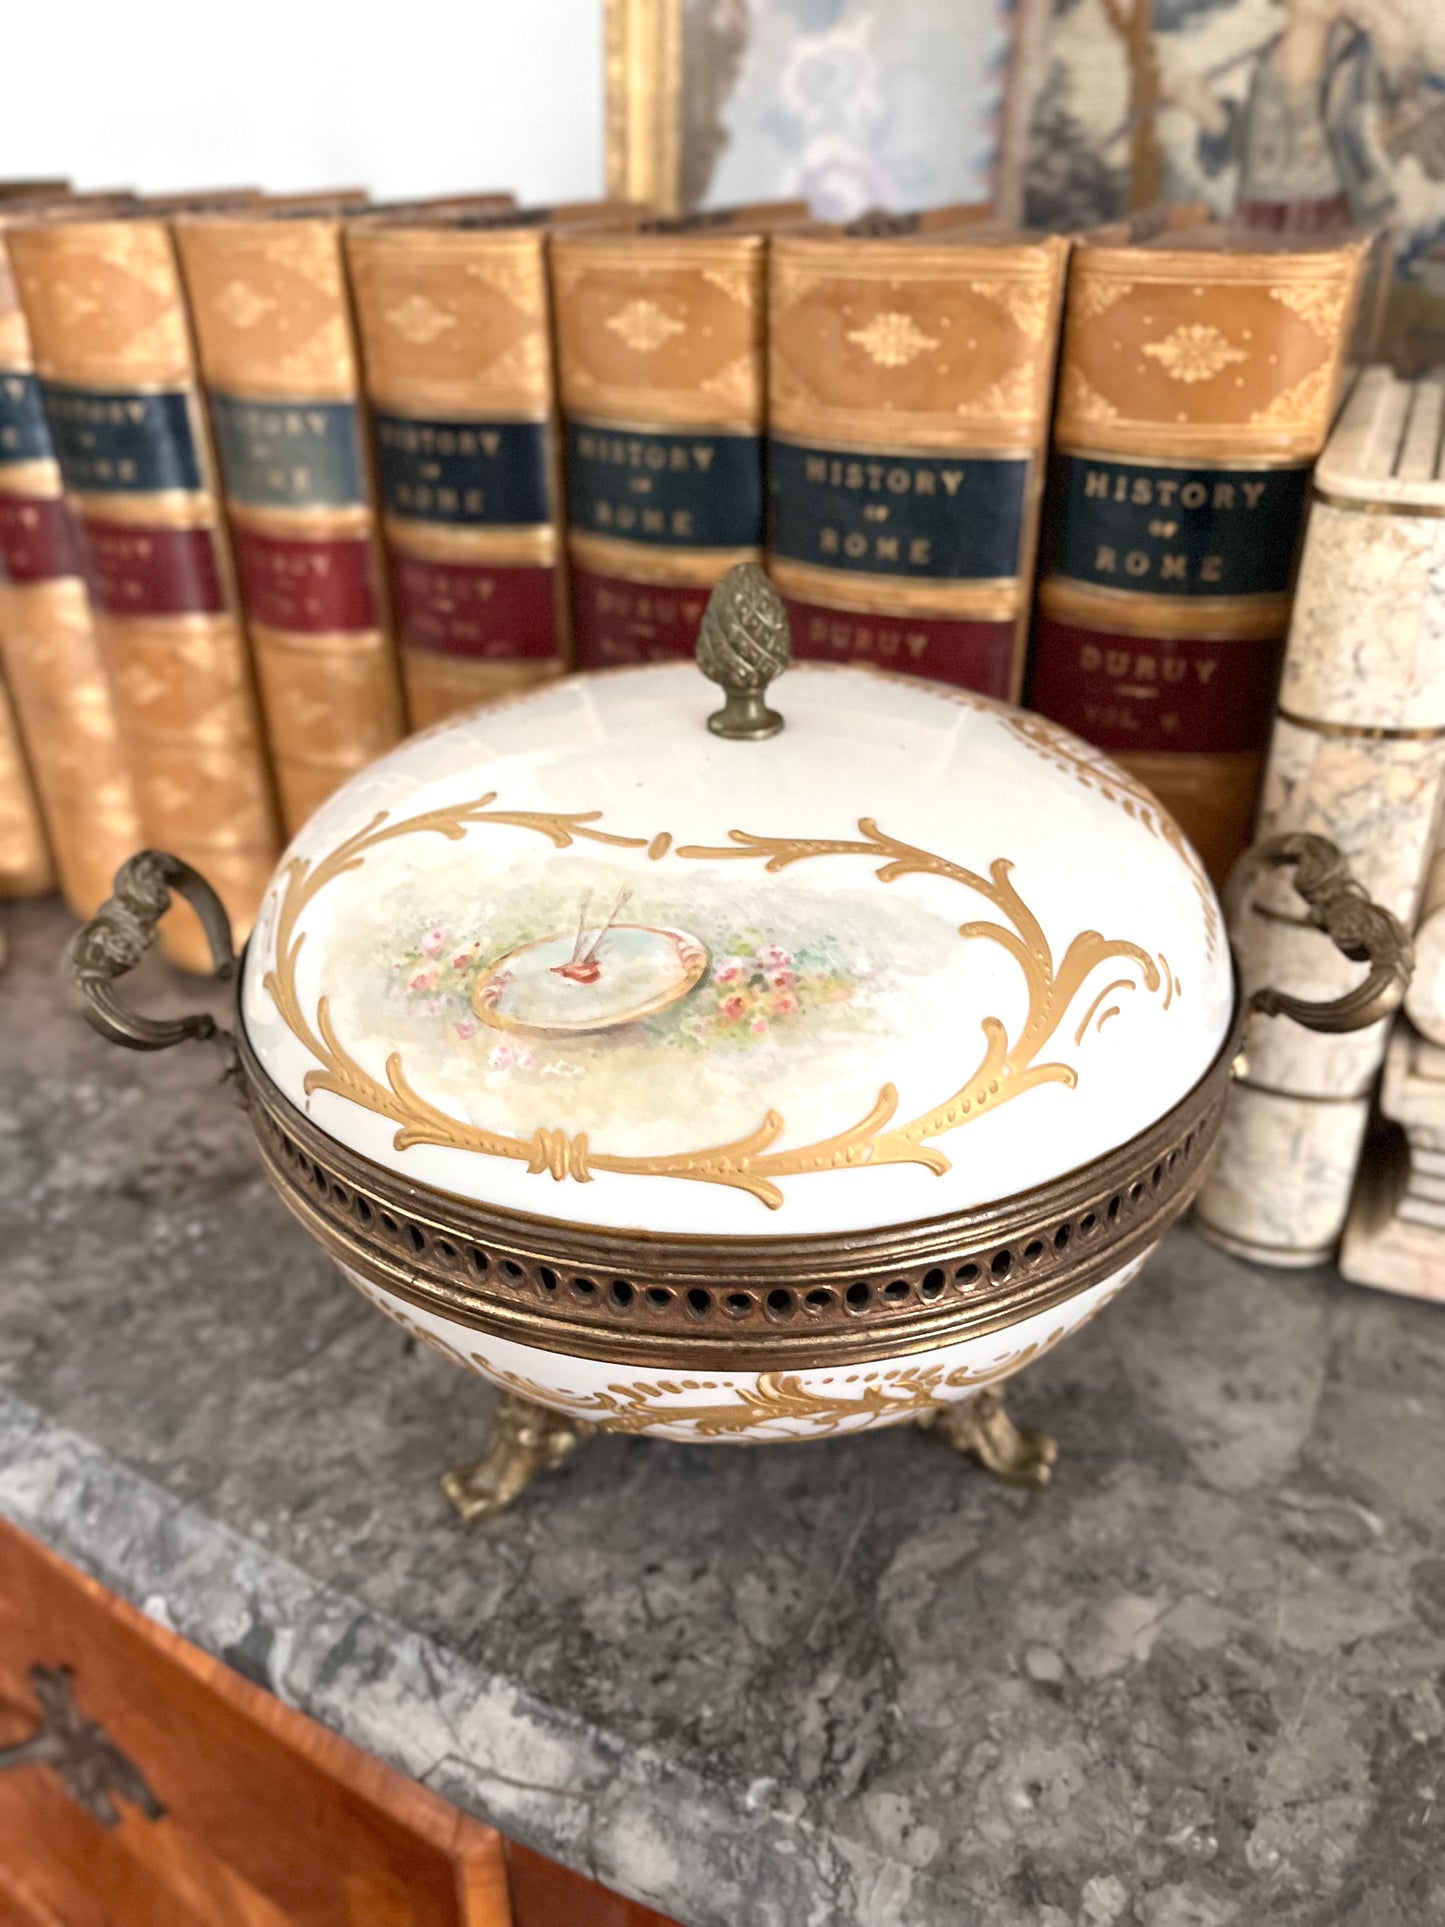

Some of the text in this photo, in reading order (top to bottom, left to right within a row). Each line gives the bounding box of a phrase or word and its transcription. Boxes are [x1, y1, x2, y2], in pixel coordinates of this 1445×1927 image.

[578, 435, 714, 473] HISTORY
[806, 456, 964, 496] HISTORY
[1084, 471, 1265, 509] HISTORY
[819, 526, 931, 566] ROME
[1094, 545, 1224, 582] ROME
[1080, 644, 1218, 684] DURUY
